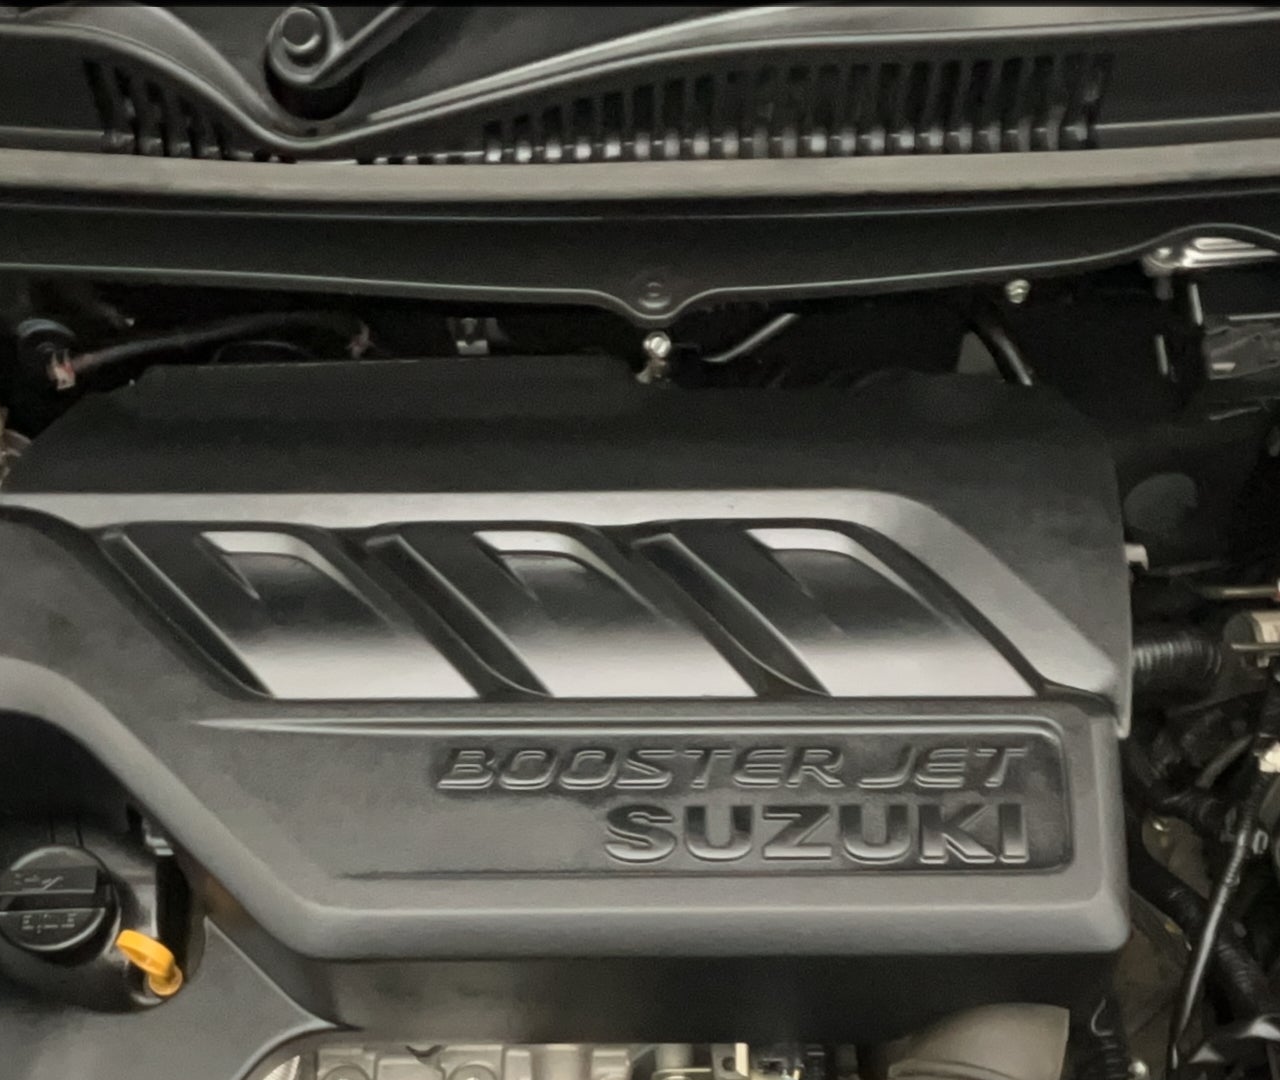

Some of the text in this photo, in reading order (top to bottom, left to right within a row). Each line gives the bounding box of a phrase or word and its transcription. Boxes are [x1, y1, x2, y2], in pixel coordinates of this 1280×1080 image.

[437, 747, 1027, 790] BOOSTER JET
[605, 803, 1030, 864] SUZUKI
